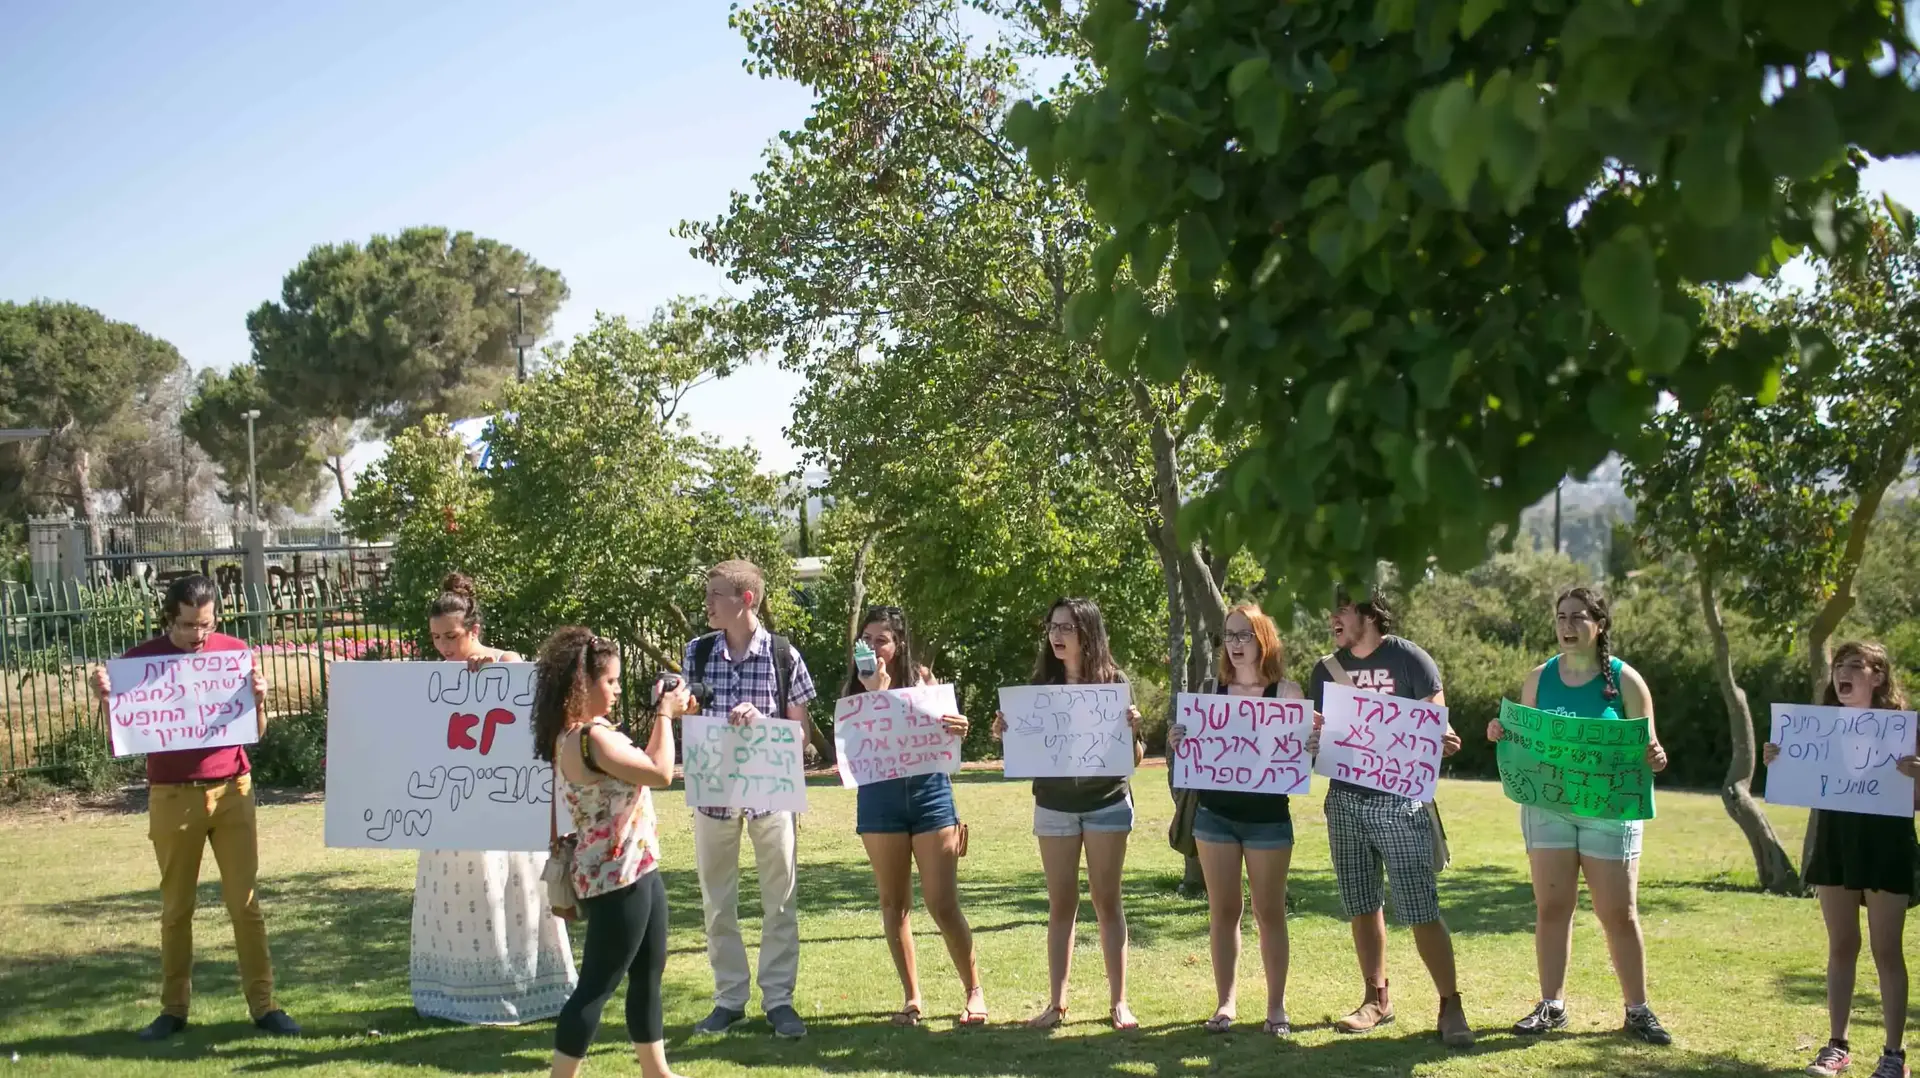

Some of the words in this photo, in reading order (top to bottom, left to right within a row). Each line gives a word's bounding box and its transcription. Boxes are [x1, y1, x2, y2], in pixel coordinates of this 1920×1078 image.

[428, 666, 537, 706] נחנו
[115, 708, 185, 727] החופש
[199, 700, 244, 724] למען
[1015, 711, 1044, 729] לא
[1052, 711, 1071, 731] הן
[1089, 703, 1121, 727] שלי
[1184, 697, 1230, 738] שלי
[1239, 700, 1303, 732] הגוף
[1353, 696, 1401, 724] בגד
[1410, 709, 1440, 730] אף
[447, 708, 516, 756] לא
[852, 718, 892, 732] כדי
[1337, 724, 1376, 749] לא
[684, 742, 723, 772] ללא
[855, 736, 890, 757] את
[1271, 732, 1302, 762] לא
[1386, 732, 1437, 756] הוא
[1252, 766, 1308, 793] בית
[1337, 763, 1425, 797] להטרדה
[1361, 753, 1435, 782] הזמנה
[689, 772, 724, 800] מין
[364, 809, 432, 841] מיני
